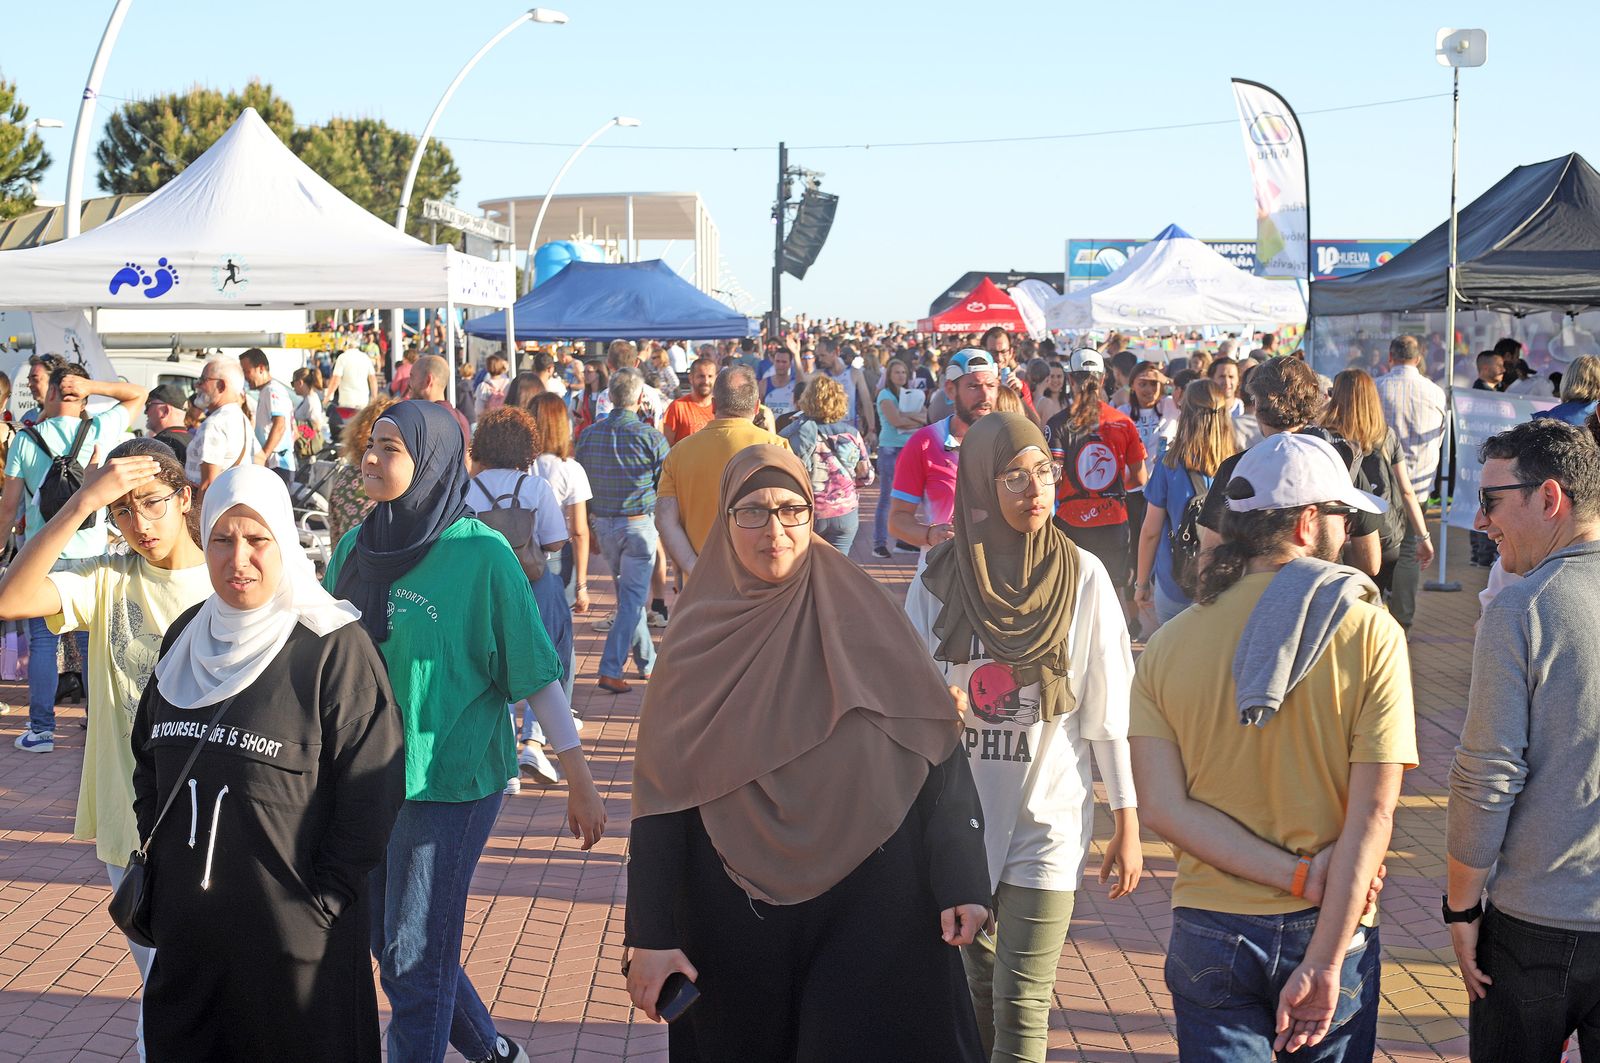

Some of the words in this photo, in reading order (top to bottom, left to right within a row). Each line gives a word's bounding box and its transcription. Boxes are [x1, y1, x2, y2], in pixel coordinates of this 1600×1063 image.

[1339, 252, 1370, 265] HUELVA
[18, 401, 35, 409] WiH
[395, 588, 428, 606] SPORTY
[426, 605, 438, 622] Co.
[160, 721, 208, 739] YOURSELF
[240, 733, 283, 758] SHORT
